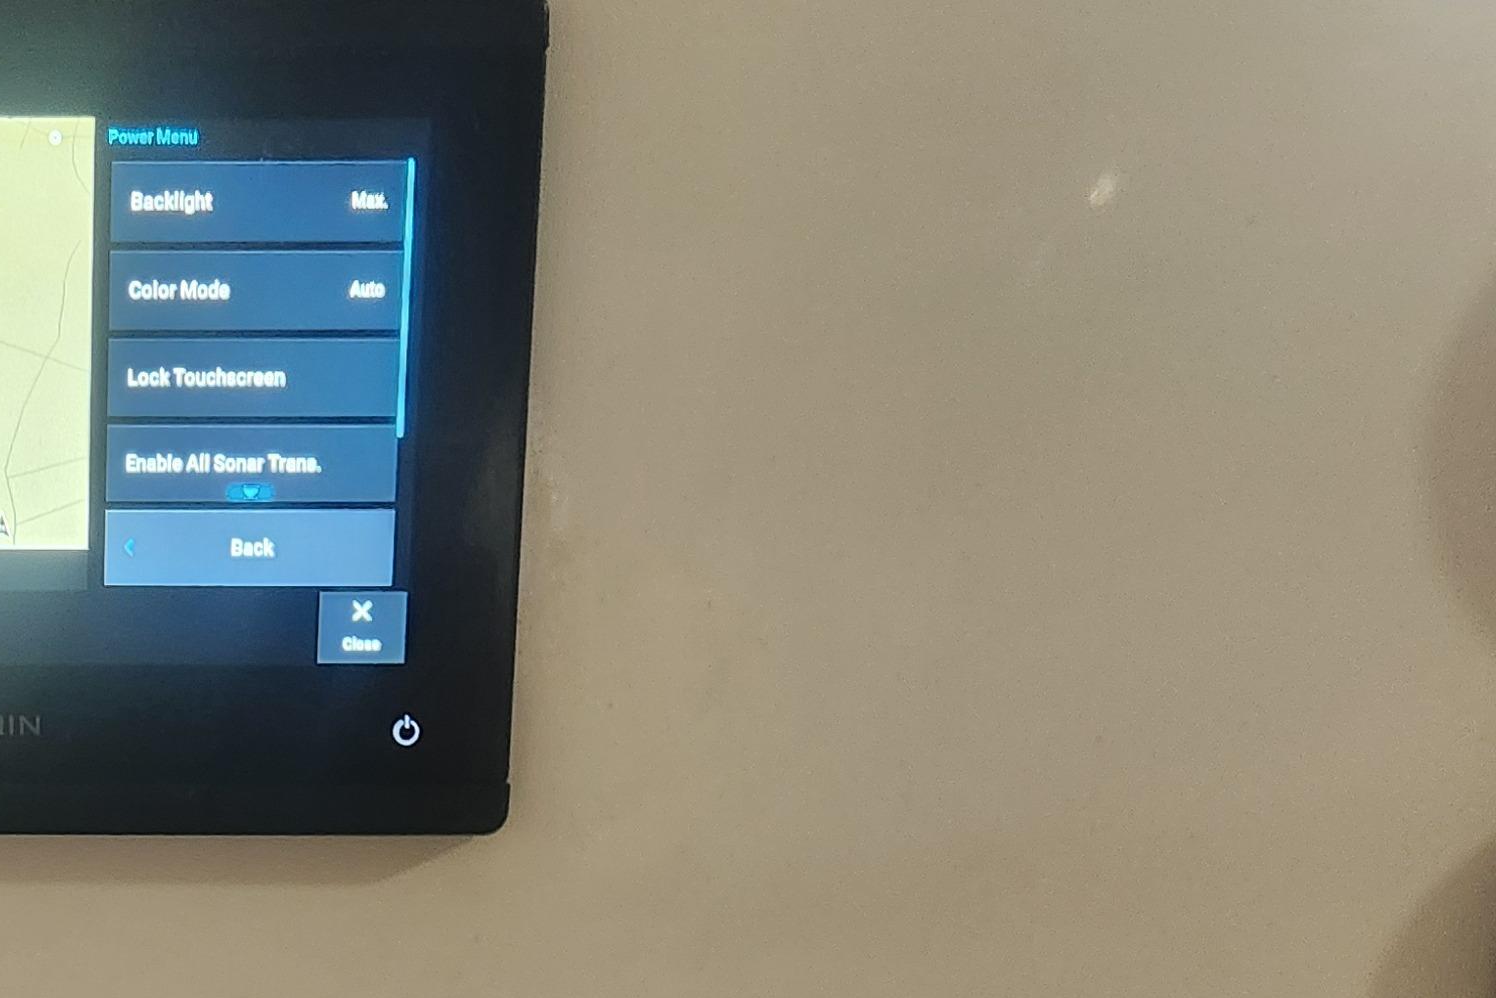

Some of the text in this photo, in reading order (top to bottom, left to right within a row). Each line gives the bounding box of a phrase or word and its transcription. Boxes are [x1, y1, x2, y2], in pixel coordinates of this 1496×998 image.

[109, 128, 198, 145] Power Menu
[130, 190, 213, 214] Backlight
[352, 191, 388, 210] Max.
[128, 279, 230, 300] Color Mode
[350, 280, 385, 298] Auto
[127, 367, 287, 387] Lock Touchscreen
[125, 453, 322, 473] Enable All Sonar Trans.
[231, 537, 275, 558] Back
[342, 636, 381, 651] Close
